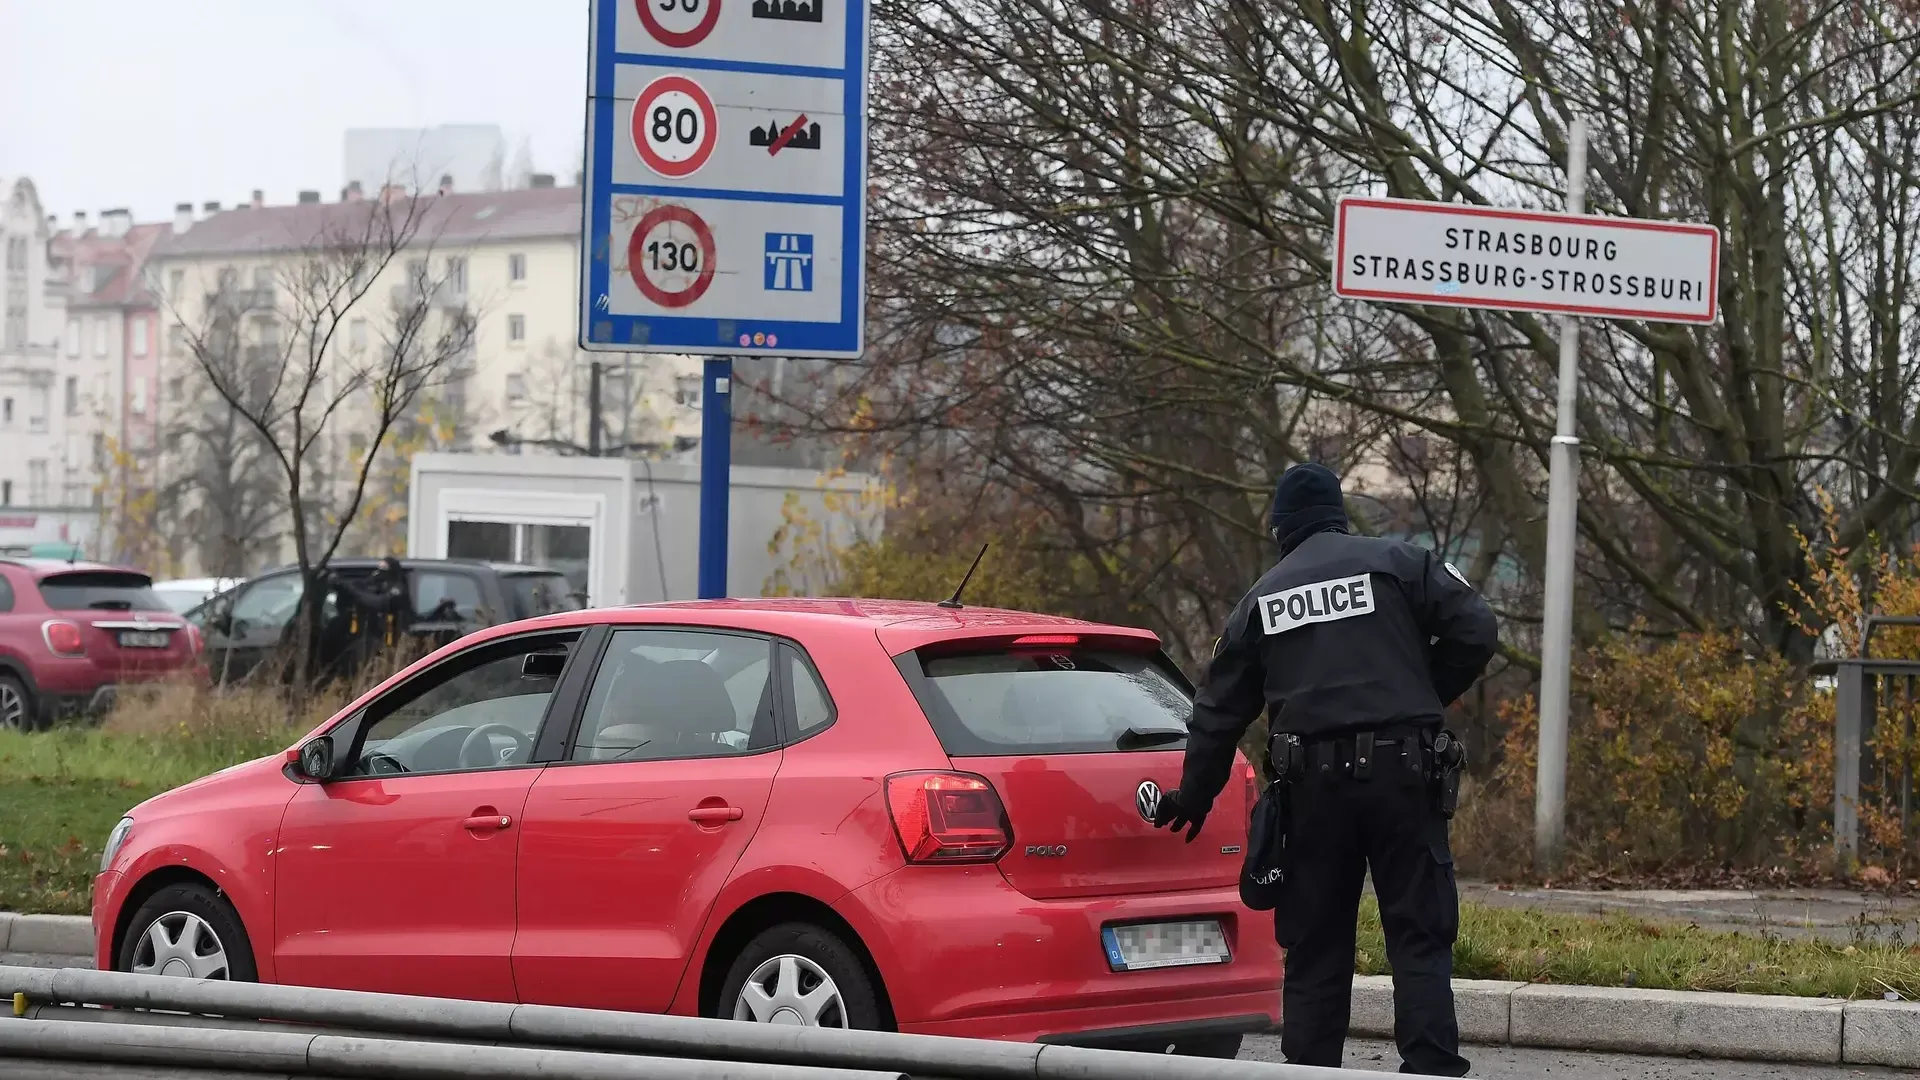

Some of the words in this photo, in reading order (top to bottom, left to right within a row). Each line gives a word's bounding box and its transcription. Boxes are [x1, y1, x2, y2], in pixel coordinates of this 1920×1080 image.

[652, 106, 698, 145] 80
[648, 241, 698, 272] 130
[1445, 227, 1617, 261] STRASBOURG
[1352, 254, 1702, 302] STRASSBURG-STROSSBURI
[1266, 580, 1368, 628] POLICE
[1025, 844, 1067, 857] POLO
[1111, 950, 1118, 959] D
